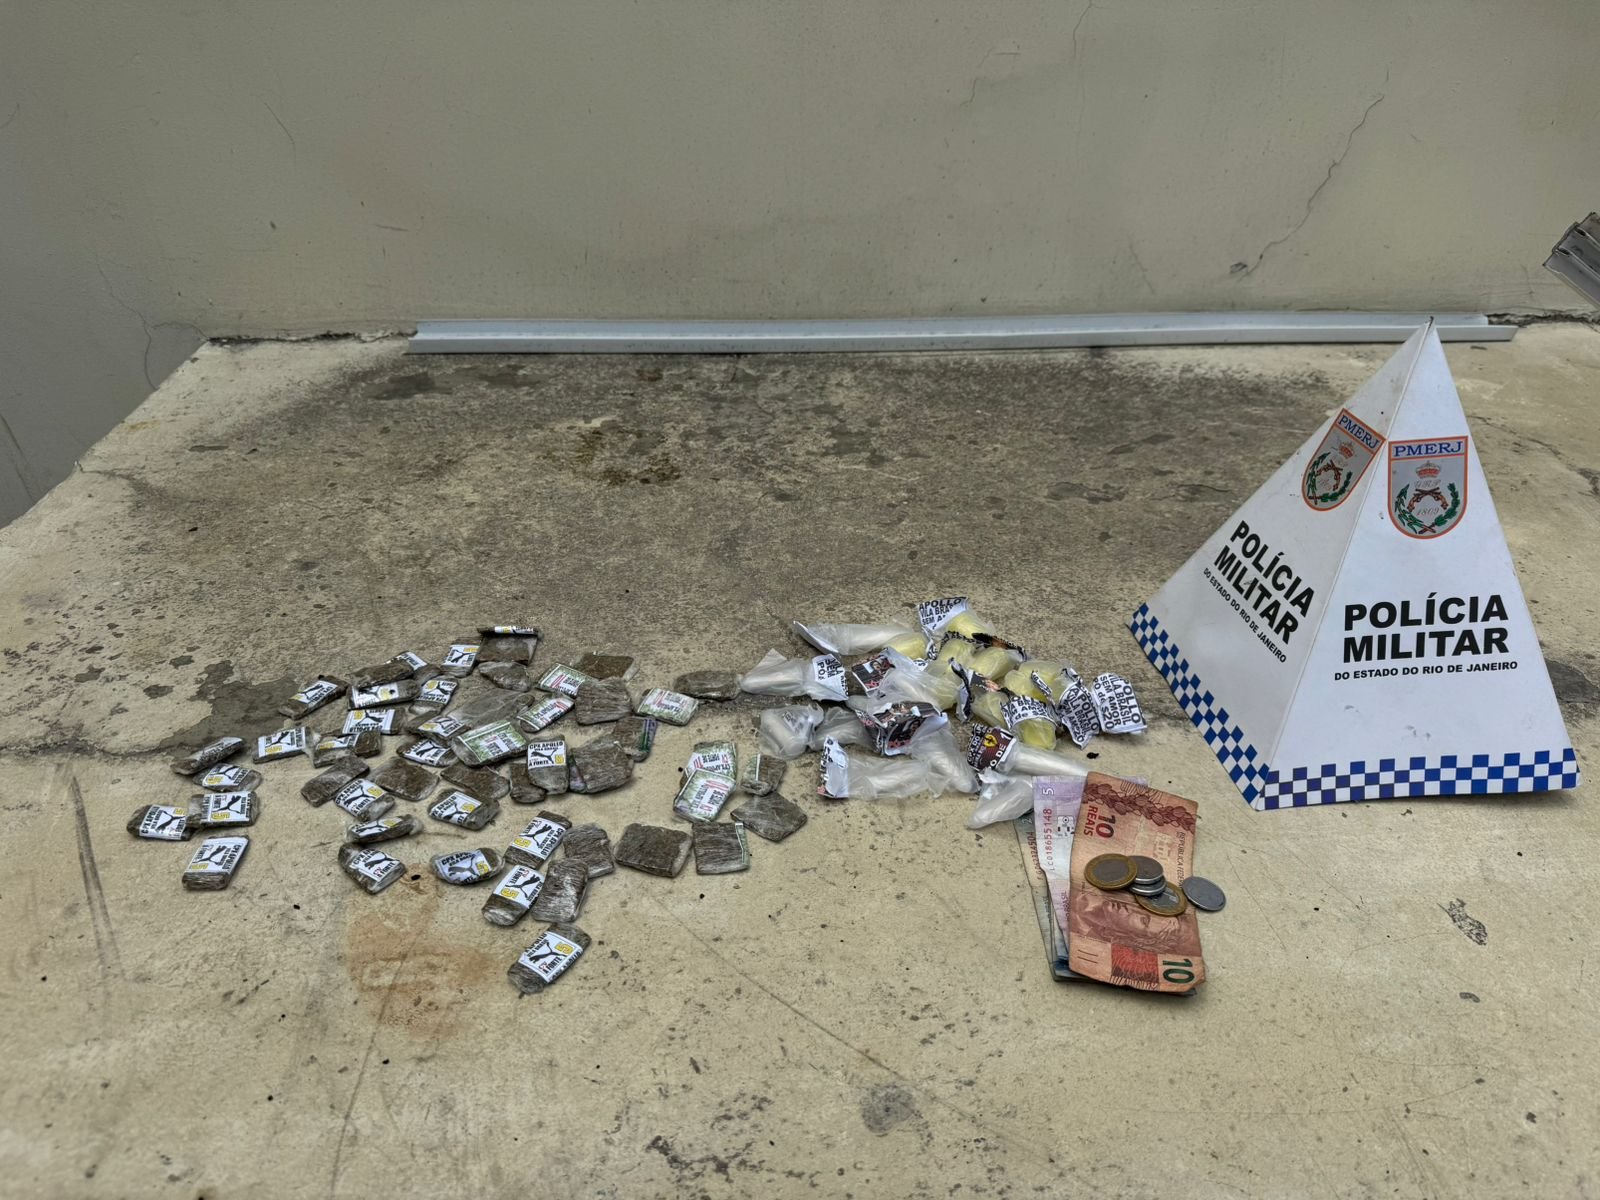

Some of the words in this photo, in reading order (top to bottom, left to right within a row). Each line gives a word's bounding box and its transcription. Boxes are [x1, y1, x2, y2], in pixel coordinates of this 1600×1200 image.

[1337, 414, 1380, 449] PMERJ
[1394, 440, 1464, 458] PMERJ
[1230, 519, 1315, 618] POLÍCIA
[919, 597, 963, 610] APOLLO
[1213, 544, 1299, 645] MILITAR
[1203, 567, 1212, 579] DO
[1209, 576, 1232, 602] ESTADO
[1230, 598, 1241, 612] DO
[1239, 608, 1251, 623] RIO
[1249, 620, 1260, 634] DE
[1257, 630, 1287, 663] JANEIRO
[1344, 591, 1509, 631] POLÍCIA
[1343, 627, 1510, 663] MILITAR
[1334, 671, 1350, 681] DO
[1353, 667, 1399, 679] ESTADO
[1402, 666, 1419, 676] DO
[1424, 665, 1444, 675] RIO
[1447, 664, 1463, 673] DE
[1466, 660, 1518, 672] JANEIRO
[1069, 687, 1099, 731] APOLLO
[1100, 676, 1113, 693] SEM
[1108, 696, 1122, 726] AMOR
[1114, 692, 1132, 726] BRASIL
[1121, 676, 1142, 724] POLLO
[1042, 786, 1054, 796] 5
[1083, 805, 1099, 837] REAIS
[1095, 813, 1117, 839] 10
[441, 855, 455, 866] CPX
[541, 836, 557, 856] APOLLO
[508, 870, 523, 885] FORTE
[545, 955, 562, 971] FORTE
[1162, 958, 1195, 984] 10
